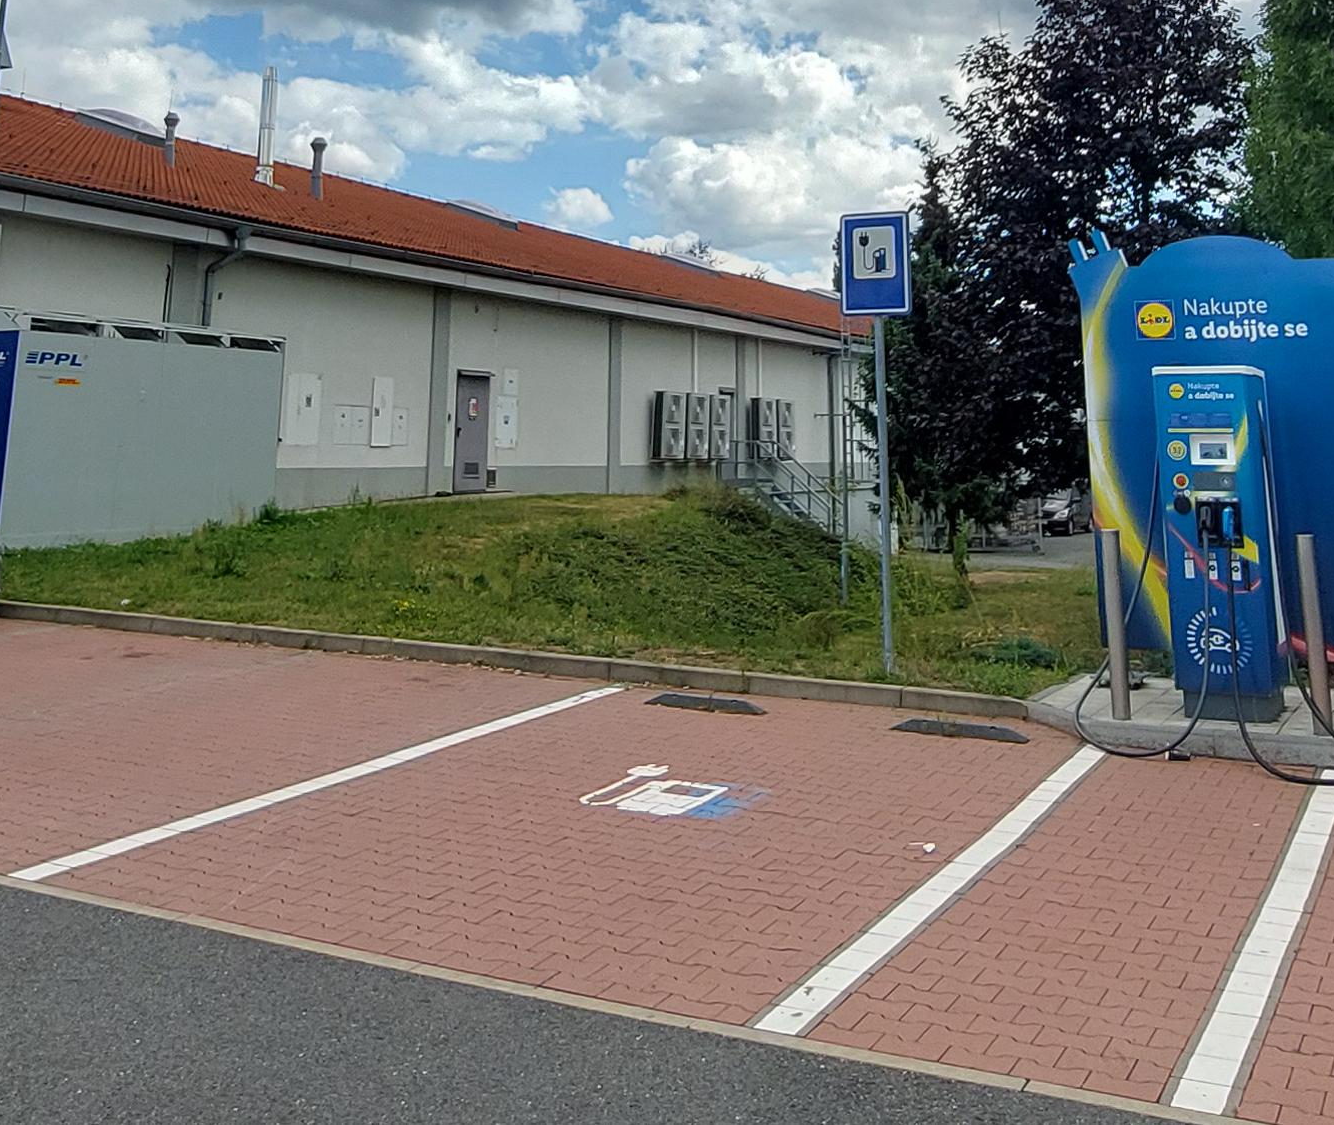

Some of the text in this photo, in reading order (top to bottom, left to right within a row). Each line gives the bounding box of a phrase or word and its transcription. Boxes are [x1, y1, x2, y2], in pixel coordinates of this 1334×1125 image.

[1183, 297, 1268, 319] Nakupte
[1184, 320, 1309, 342] a dobijte se
[38, 352, 83, 367] PPL
[1186, 382, 1220, 391] Nakupte
[1194, 391, 1224, 401] dobijte
